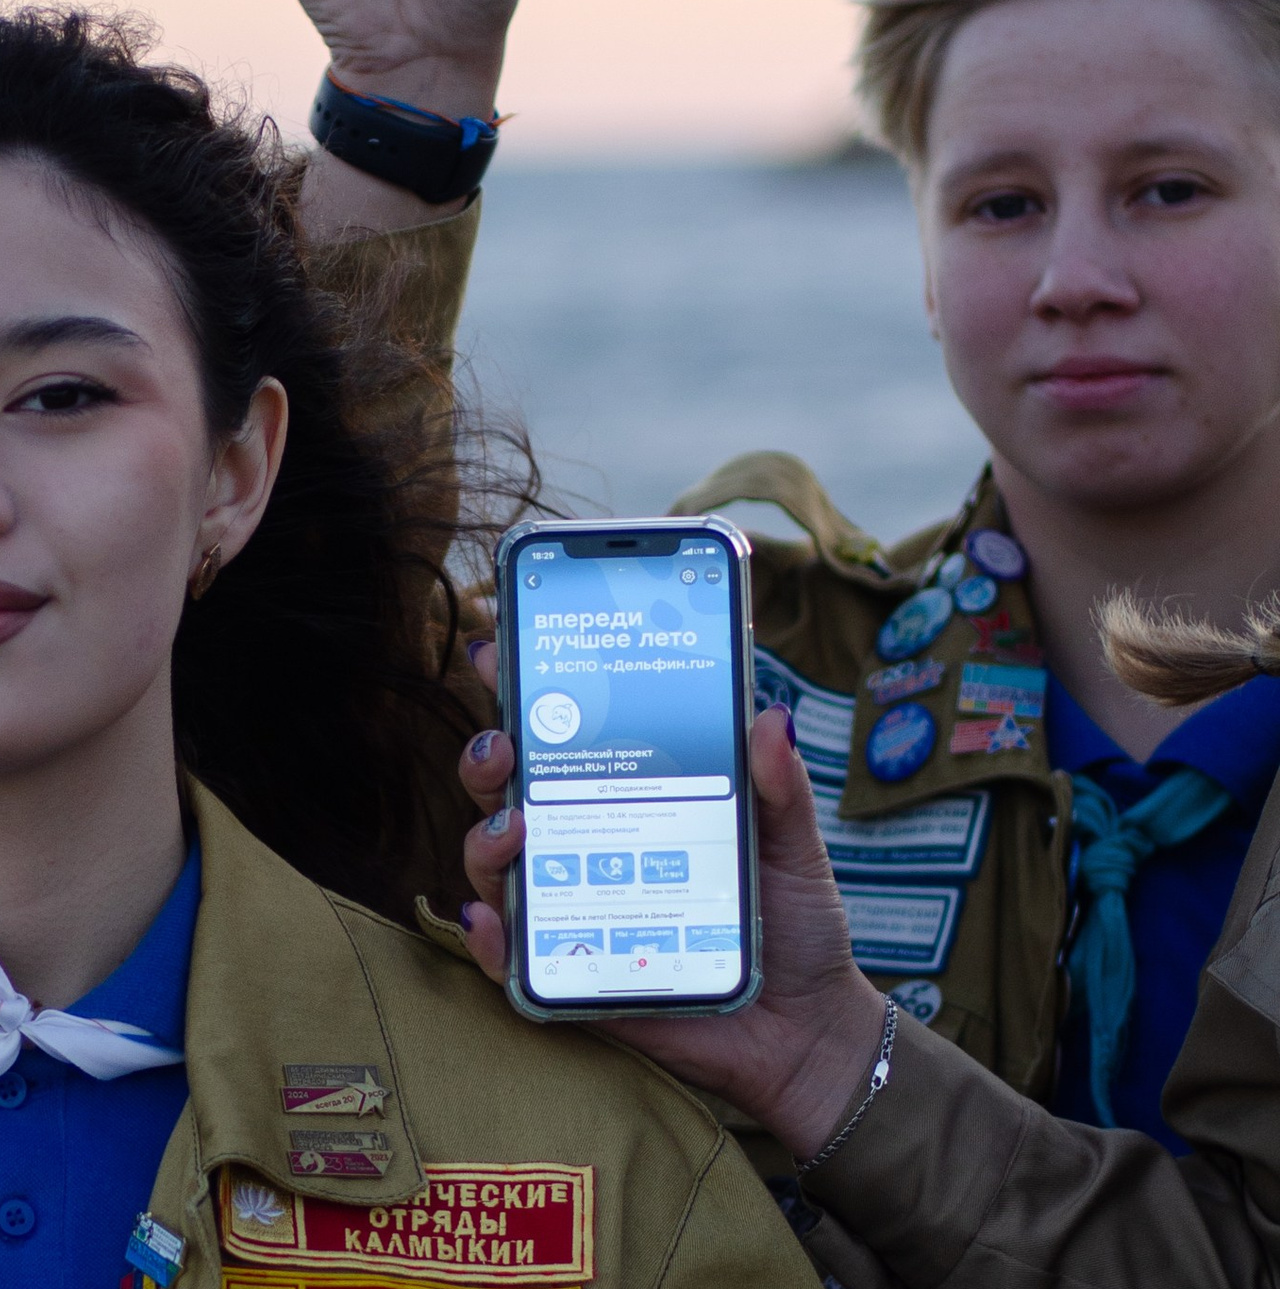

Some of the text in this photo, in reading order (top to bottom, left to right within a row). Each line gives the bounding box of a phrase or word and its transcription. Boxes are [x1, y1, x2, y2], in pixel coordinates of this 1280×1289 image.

[534, 611, 642, 633] впереди
[534, 631, 698, 656] лучшее лето
[555, 656, 715, 674] ВСПО «Дельфин.ru»
[529, 749, 653, 761] Всероссийский проект
[529, 762, 637, 774] «Дельфин.RU» РСО
[610, 784, 662, 793] Продвижение
[287, 1091, 309, 1099] 2024
[368, 1090, 384, 1098] РСО
[401, 1183, 568, 1208] НЧЕСКИЕ
[370, 1207, 506, 1238] ОТРЯДЫ
[345, 1227, 534, 1265] КАЛМЫКИИ
